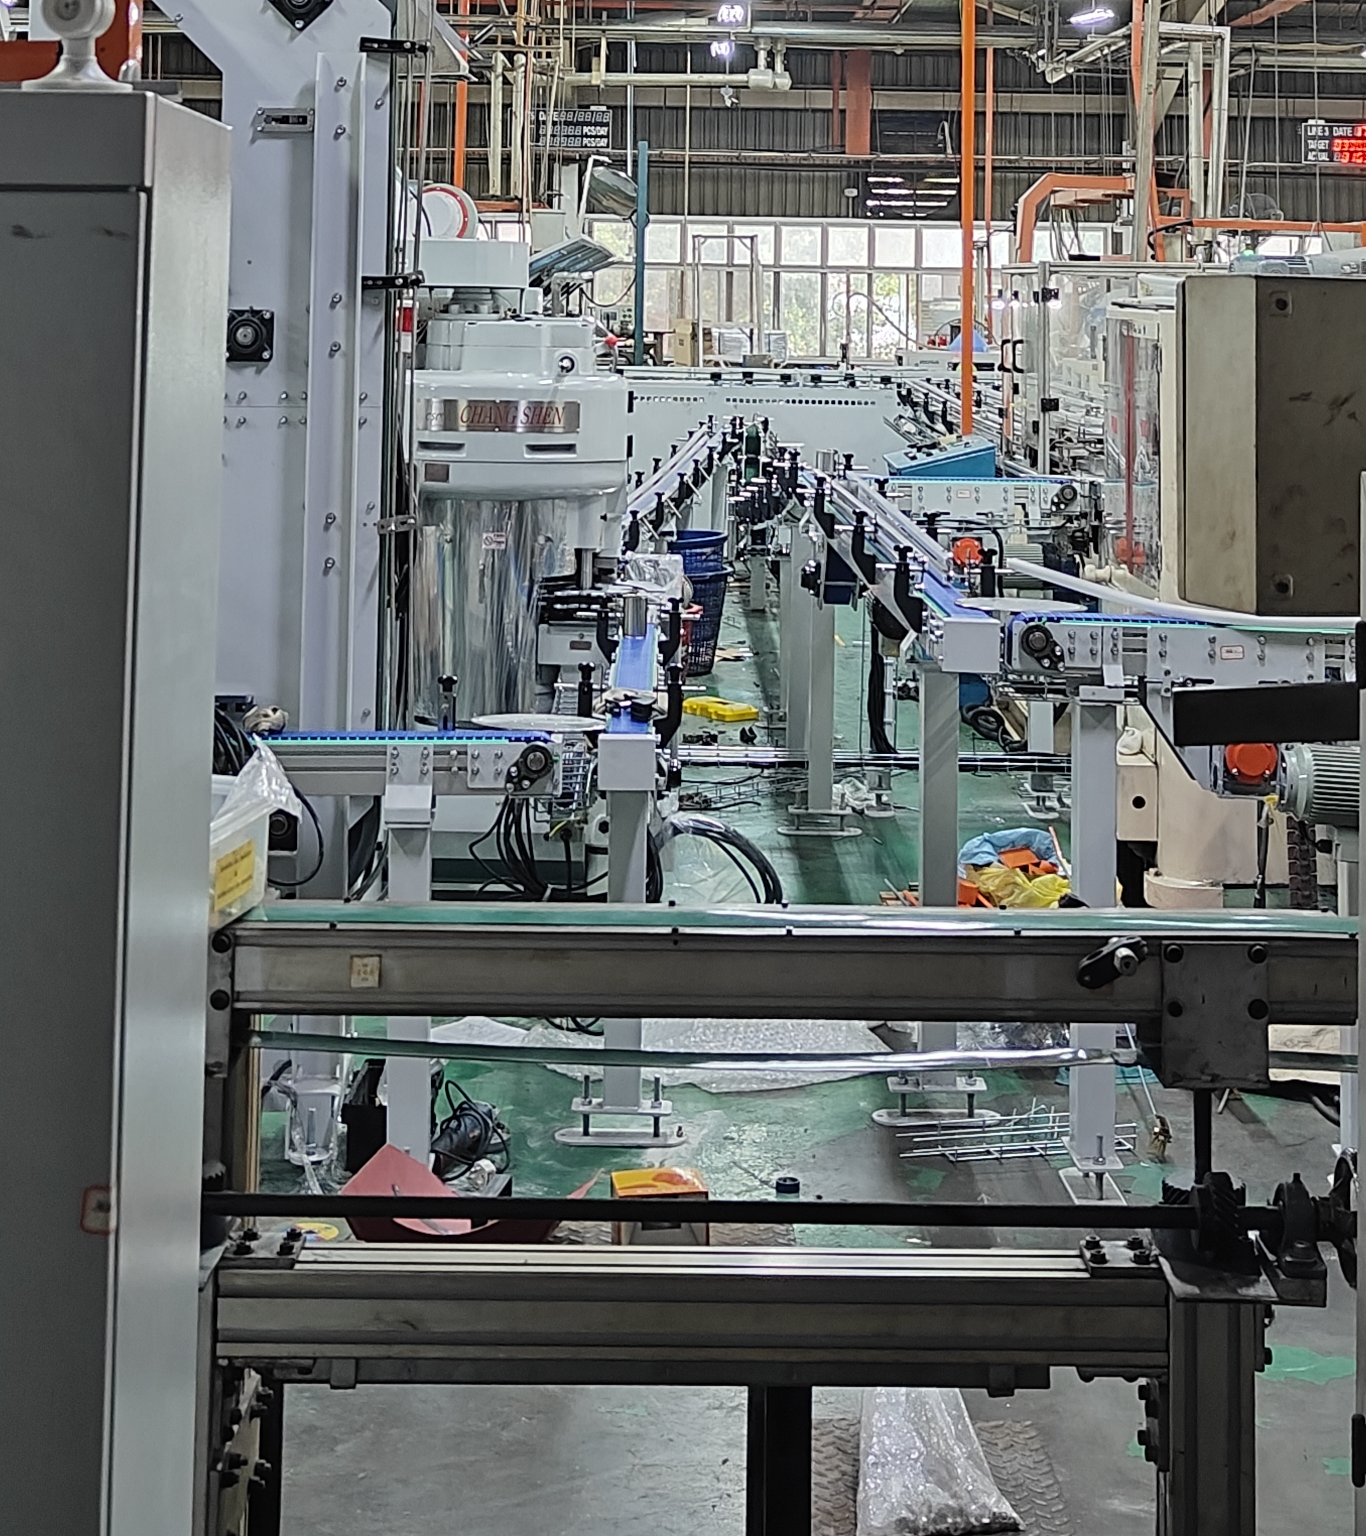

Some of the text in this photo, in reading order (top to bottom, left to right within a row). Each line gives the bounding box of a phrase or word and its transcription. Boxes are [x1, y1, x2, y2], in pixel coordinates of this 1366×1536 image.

[1333, 126, 1353, 137] DATE
[460, 403, 566, 425] CHANG SHEN
